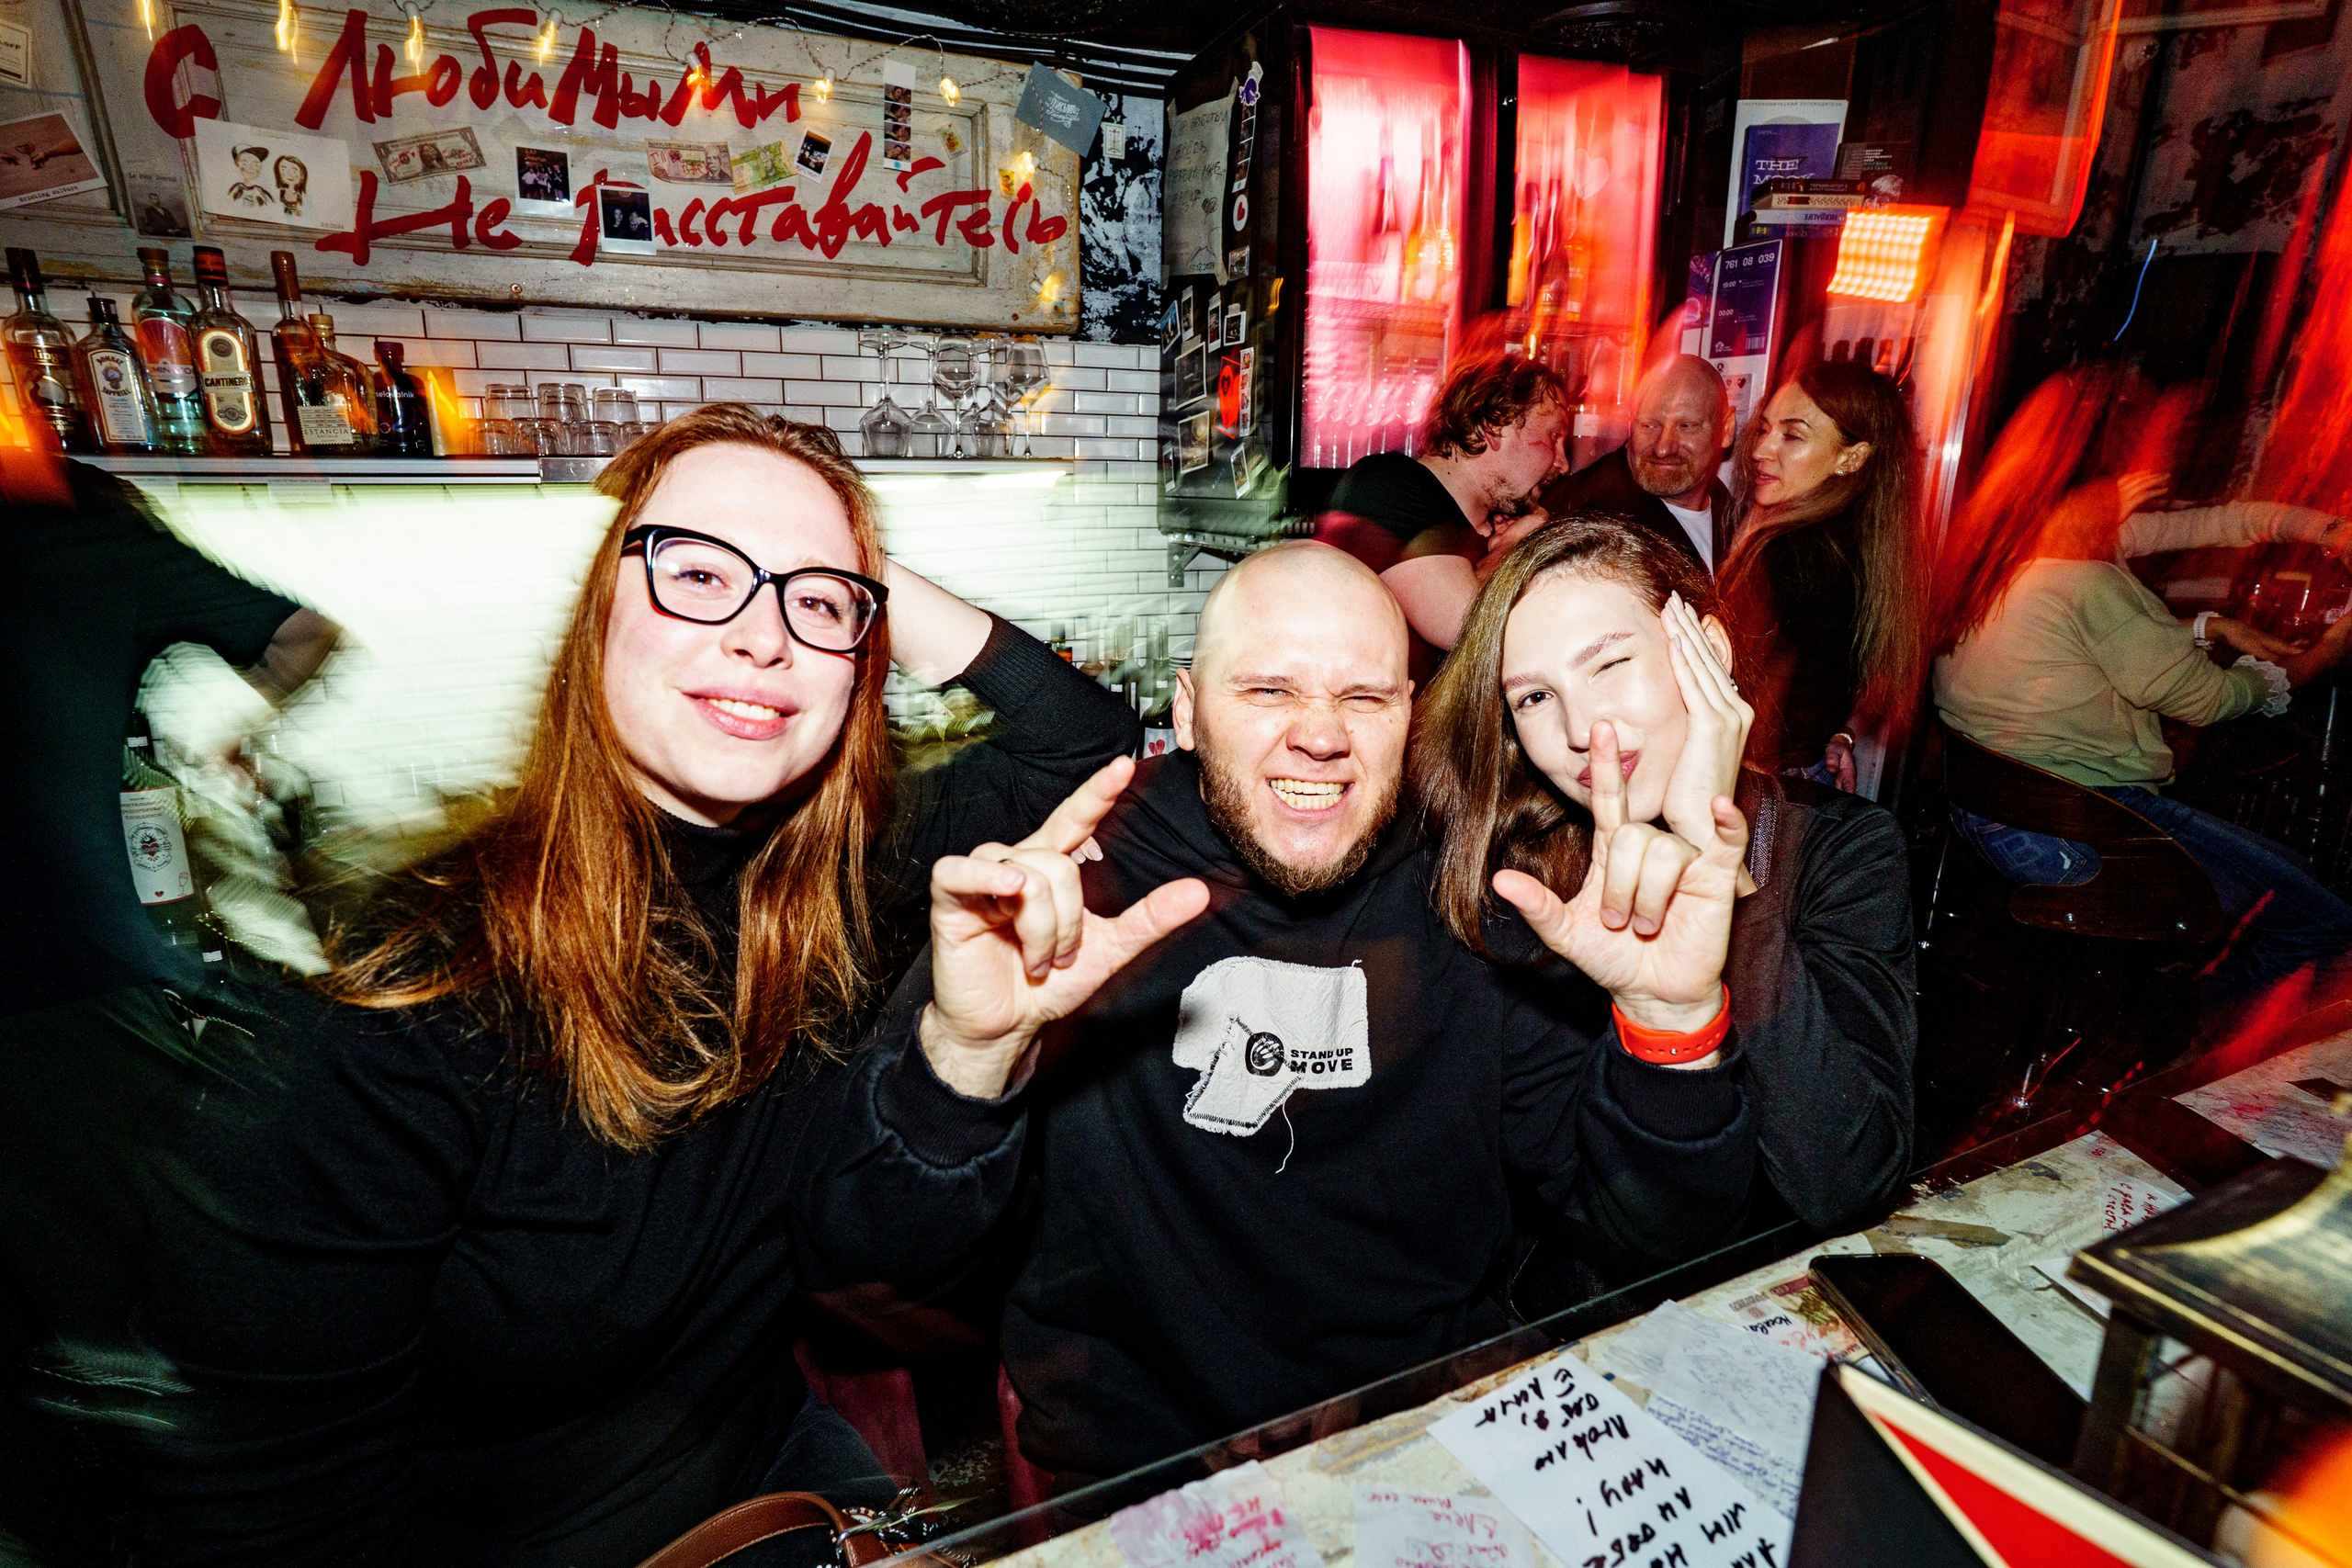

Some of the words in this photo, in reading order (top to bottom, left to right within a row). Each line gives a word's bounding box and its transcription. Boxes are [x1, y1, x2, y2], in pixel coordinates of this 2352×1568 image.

[144, 25, 221, 139] С
[1755, 159, 1799, 171] THE
[1742, 255, 1754, 266] 08
[1758, 252, 1775, 264] 039
[1290, 1049, 1334, 1059] STAND
[1336, 1047, 1354, 1057] UP
[1289, 1058, 1353, 1074] MOVE
